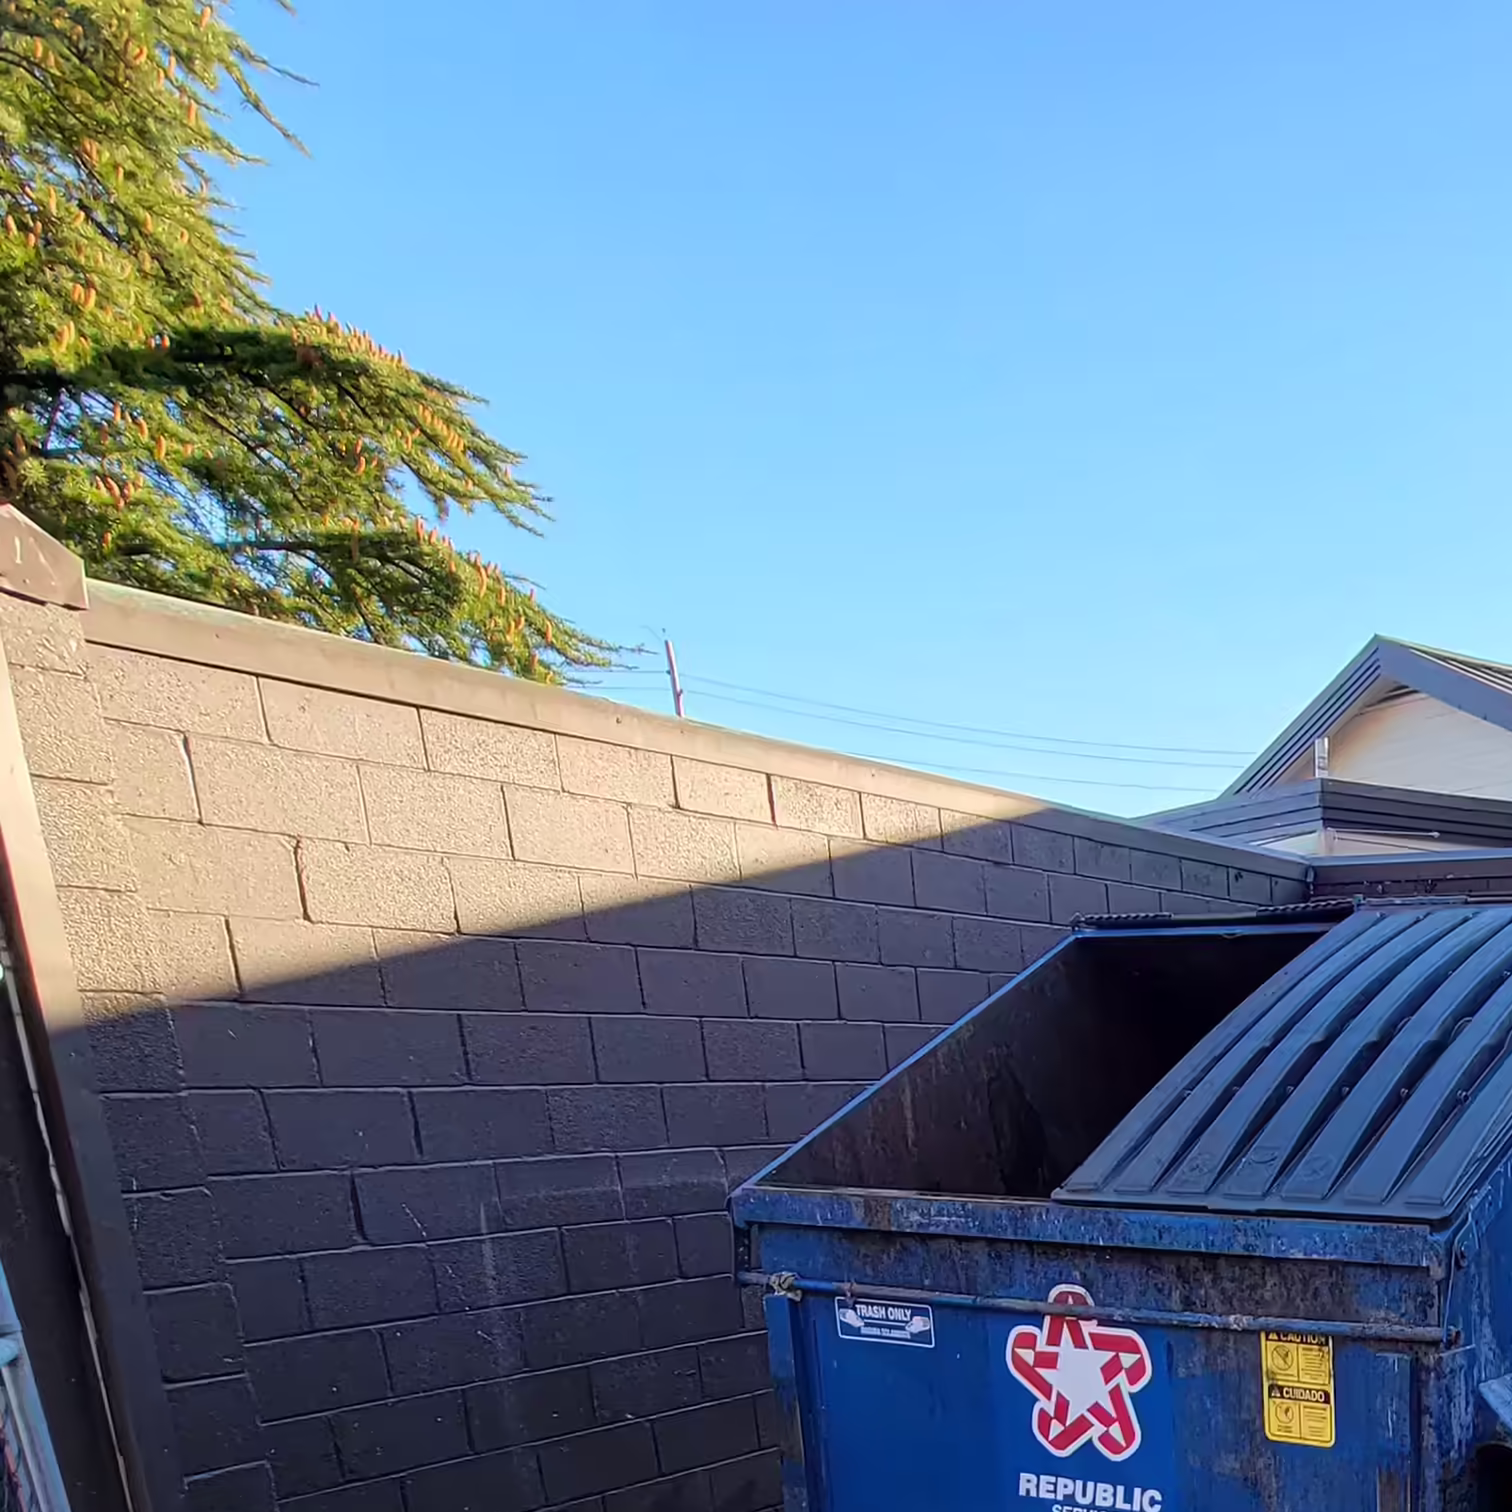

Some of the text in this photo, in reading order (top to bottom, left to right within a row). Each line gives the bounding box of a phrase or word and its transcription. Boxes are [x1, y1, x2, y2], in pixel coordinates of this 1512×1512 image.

[855, 1304, 911, 1321] TRASH ONLY
[1280, 1332, 1326, 1344] CAUTION
[1283, 1387, 1325, 1402] CUIDADO
